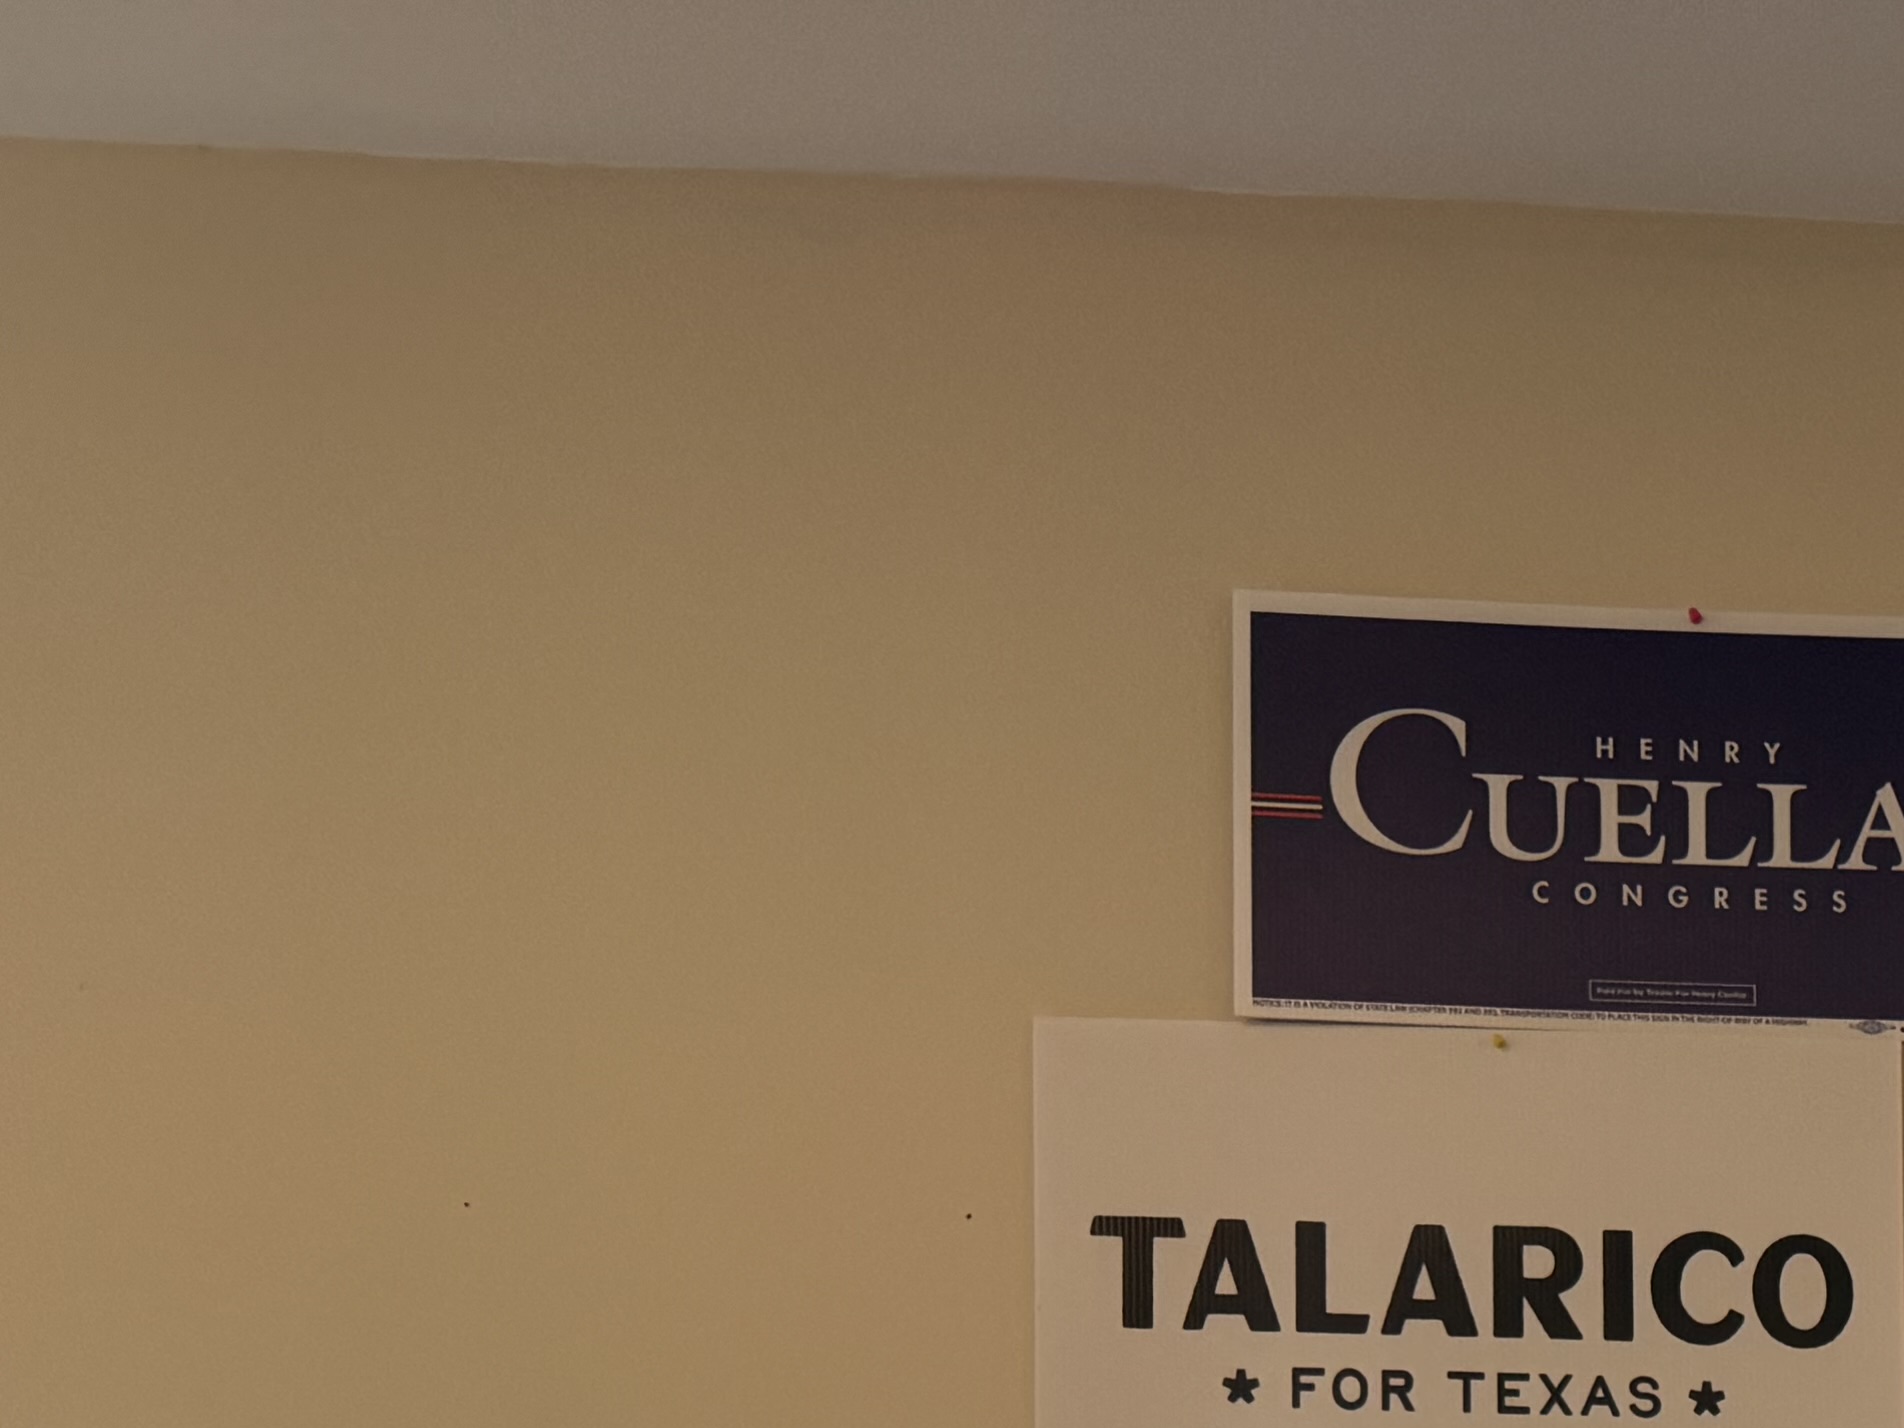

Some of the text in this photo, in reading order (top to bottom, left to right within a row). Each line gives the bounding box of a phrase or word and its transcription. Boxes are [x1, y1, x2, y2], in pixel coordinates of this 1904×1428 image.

[1596, 737, 1785, 764] HENRY
[1531, 880, 1849, 914] CONGRESS
[1089, 1214, 1854, 1349] TALARICO
[1291, 1366, 1663, 1420] FOR TEXAS
